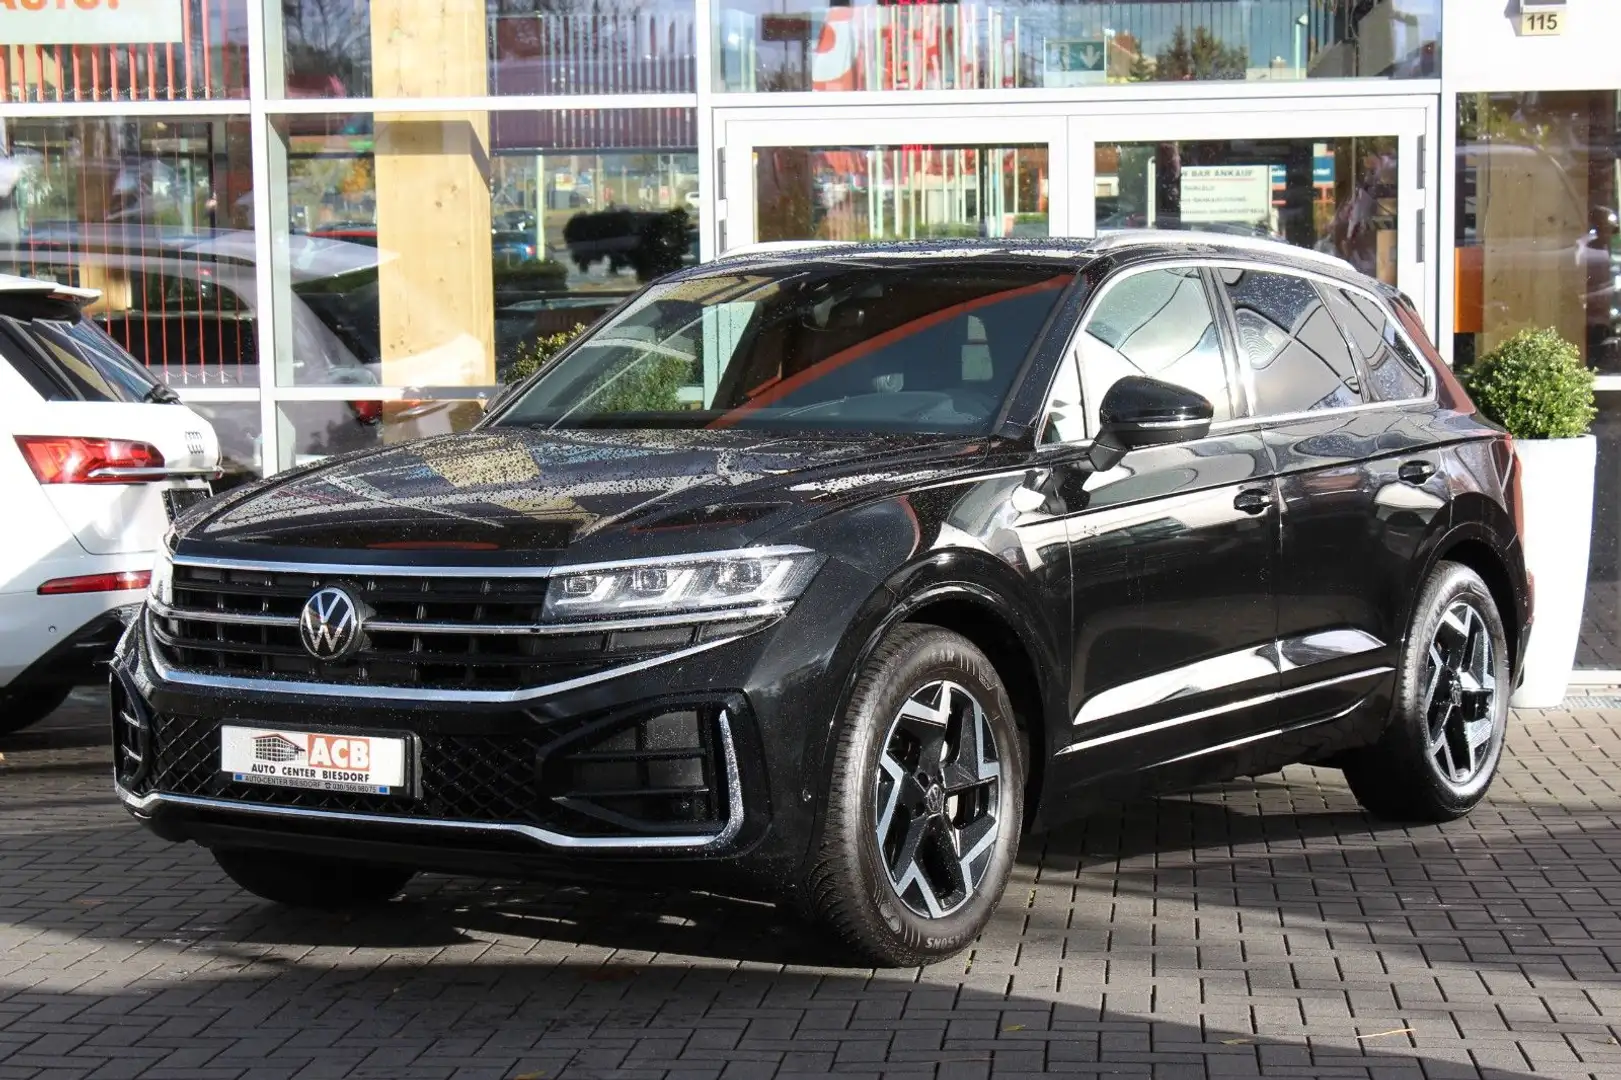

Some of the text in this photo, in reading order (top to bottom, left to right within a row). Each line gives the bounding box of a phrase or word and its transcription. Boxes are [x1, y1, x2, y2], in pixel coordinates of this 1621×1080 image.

[1526, 14, 1558, 31] 115
[309, 737, 370, 769] ACB
[251, 763, 370, 782] AUTO CENTER BIESDORF
